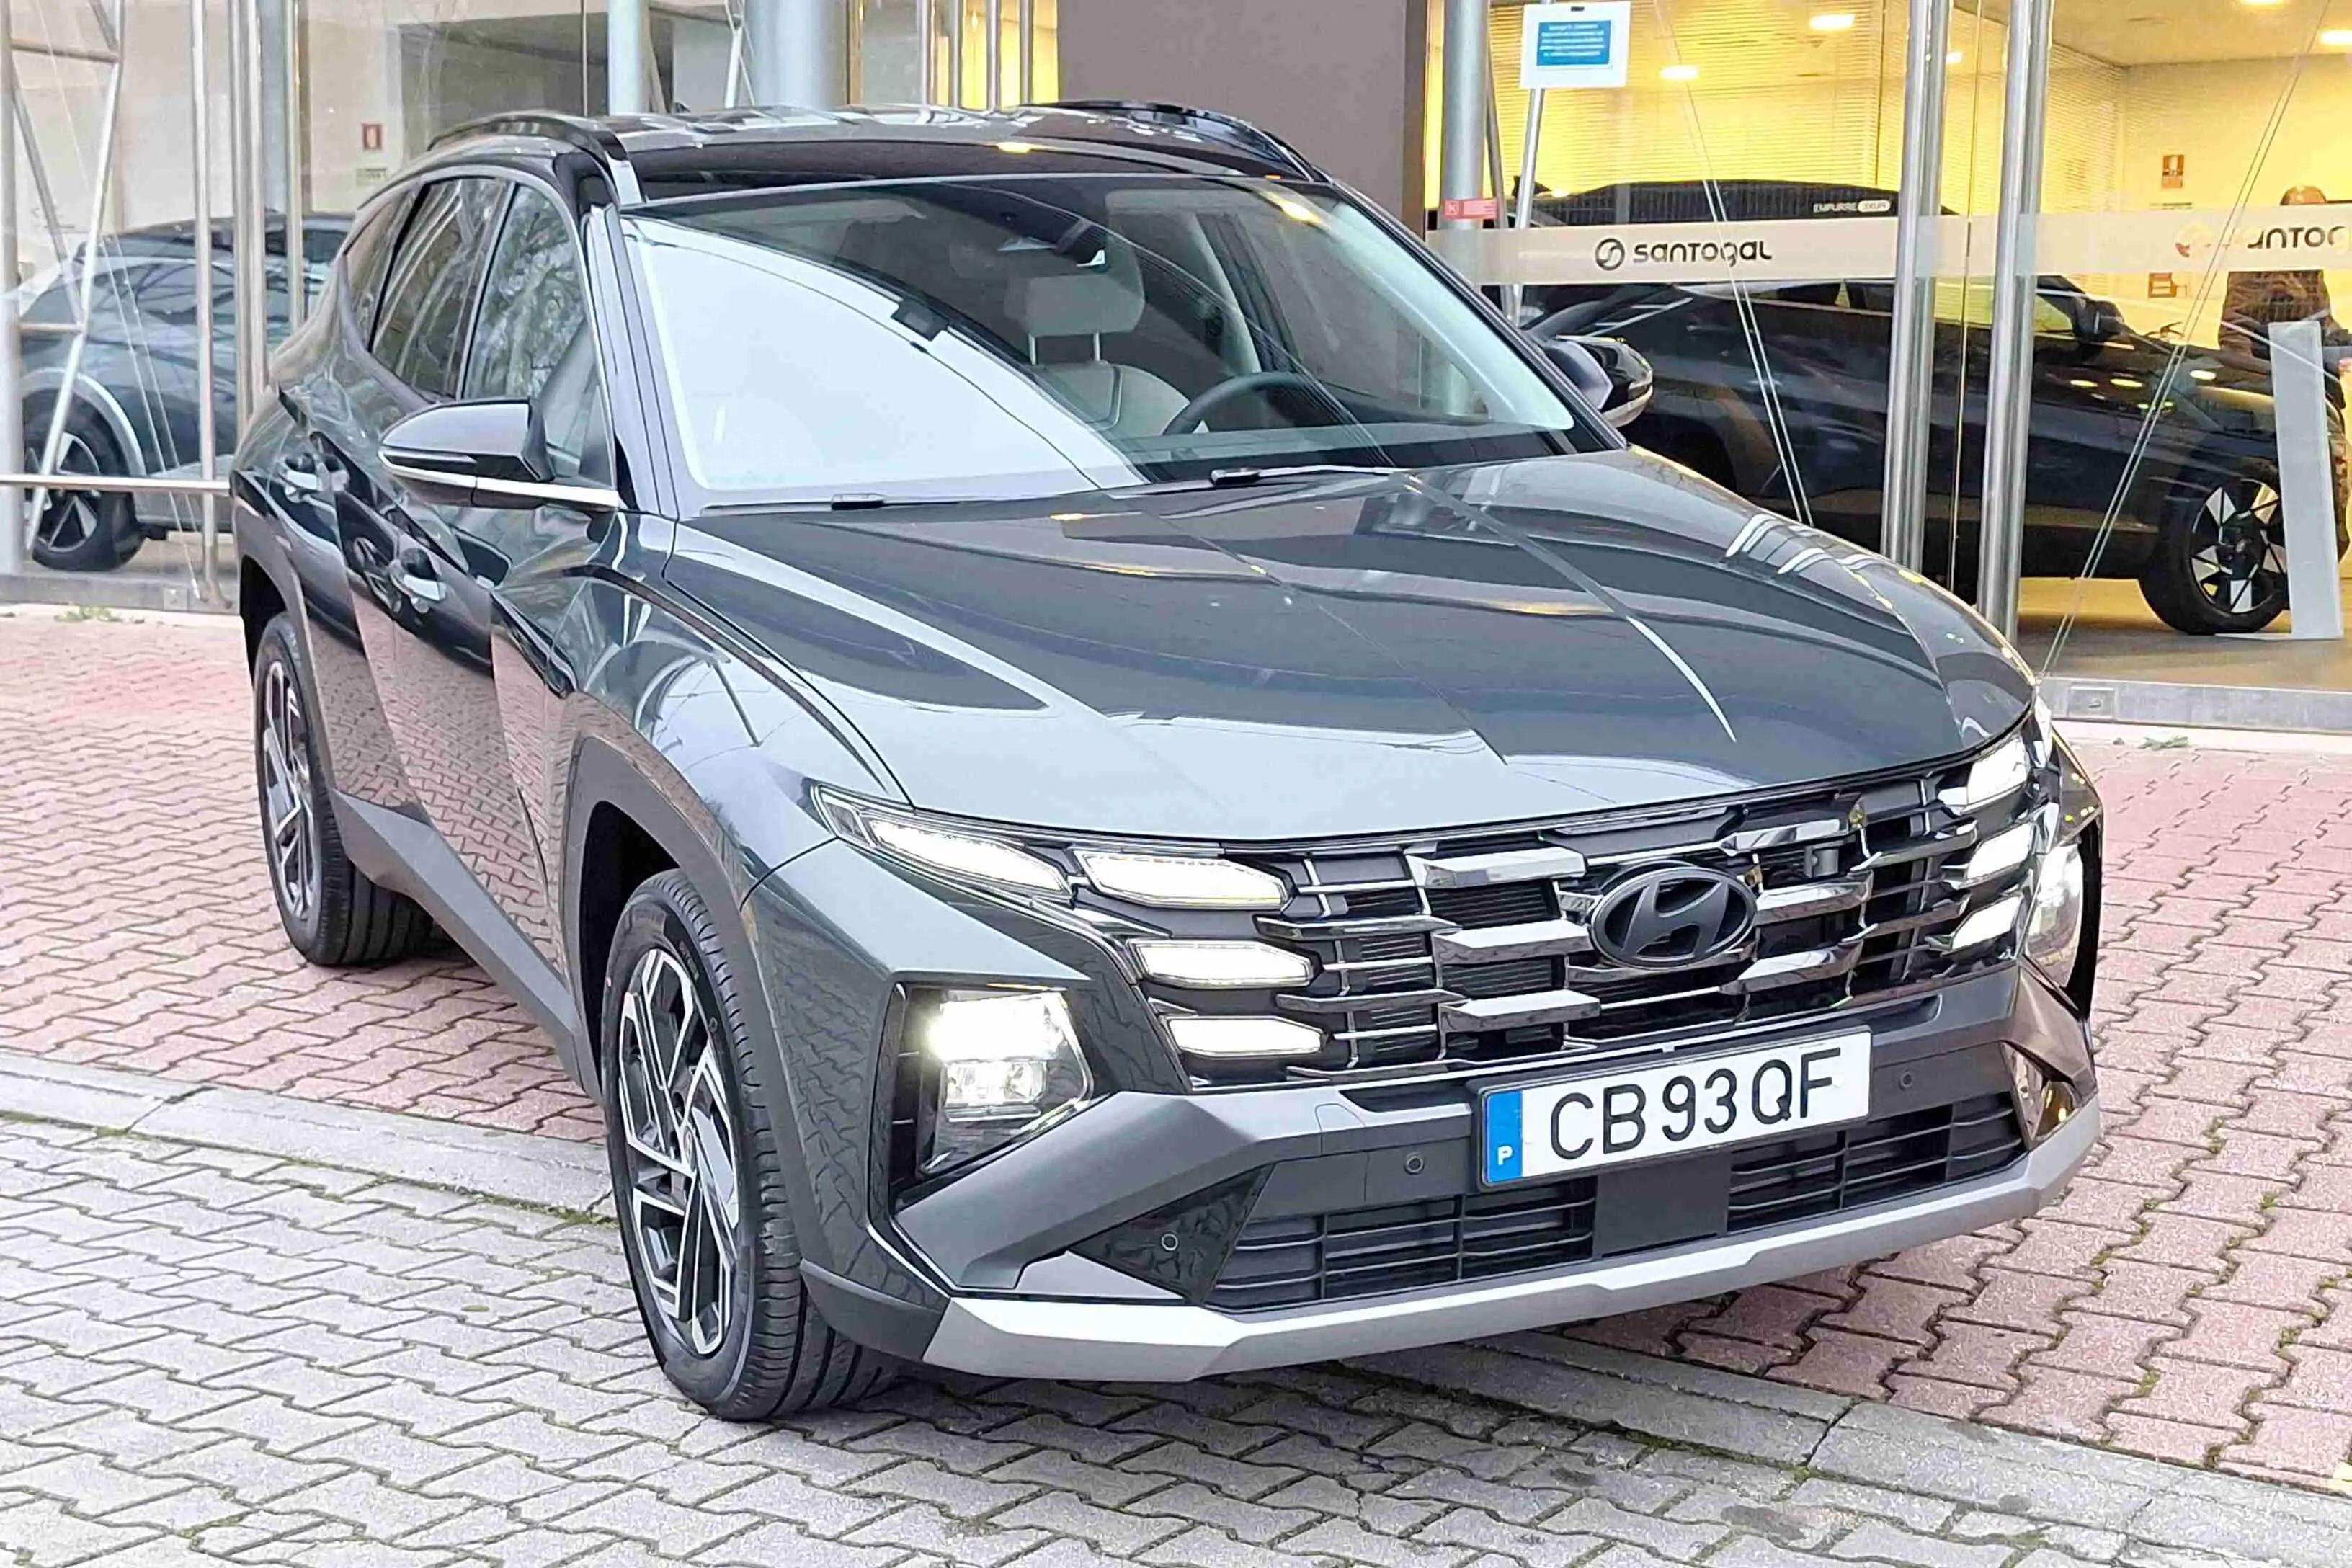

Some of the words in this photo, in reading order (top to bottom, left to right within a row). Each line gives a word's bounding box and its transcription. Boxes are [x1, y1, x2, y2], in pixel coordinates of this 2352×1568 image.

[1550, 1083, 1646, 1160] CB
[1662, 1068, 1737, 1142] 93
[1751, 1047, 1841, 1125] QF
[1497, 1145, 1513, 1165] P
